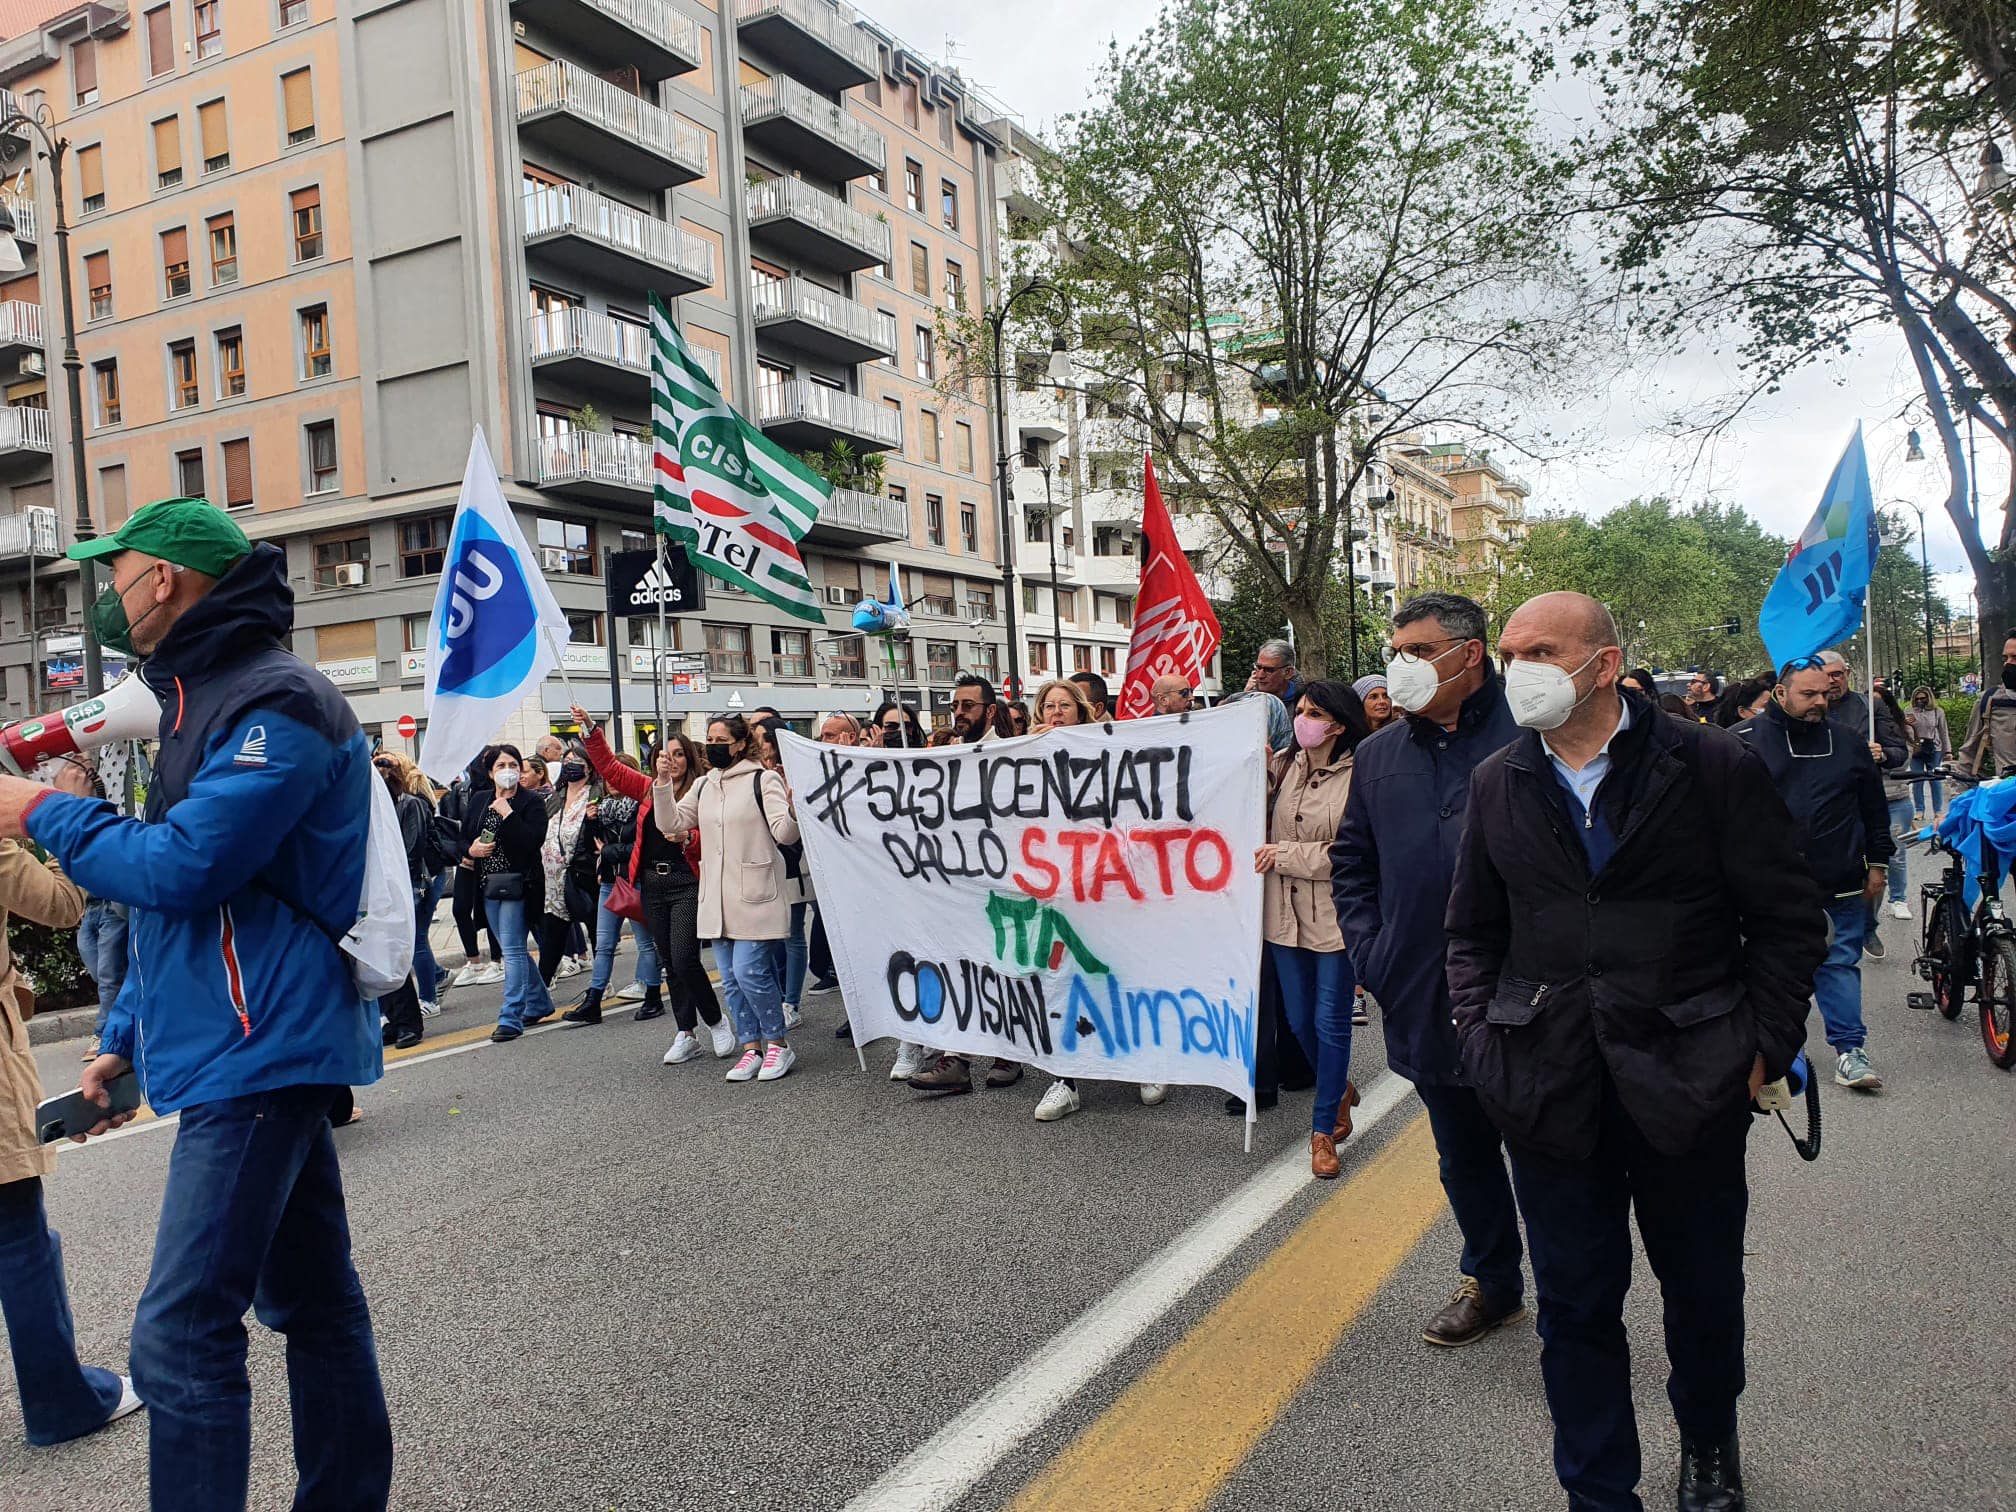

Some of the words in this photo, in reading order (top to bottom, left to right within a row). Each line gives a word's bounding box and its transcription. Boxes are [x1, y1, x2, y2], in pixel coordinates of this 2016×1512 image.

[691, 434, 762, 490] CISL
[693, 517, 761, 579] Tel
[331, 665, 373, 677] cloudtec
[562, 651, 604, 662] cloudtec
[882, 828, 1007, 885] DALLO
[1012, 826, 1232, 902] STATO
[985, 889, 1110, 974] ITA
